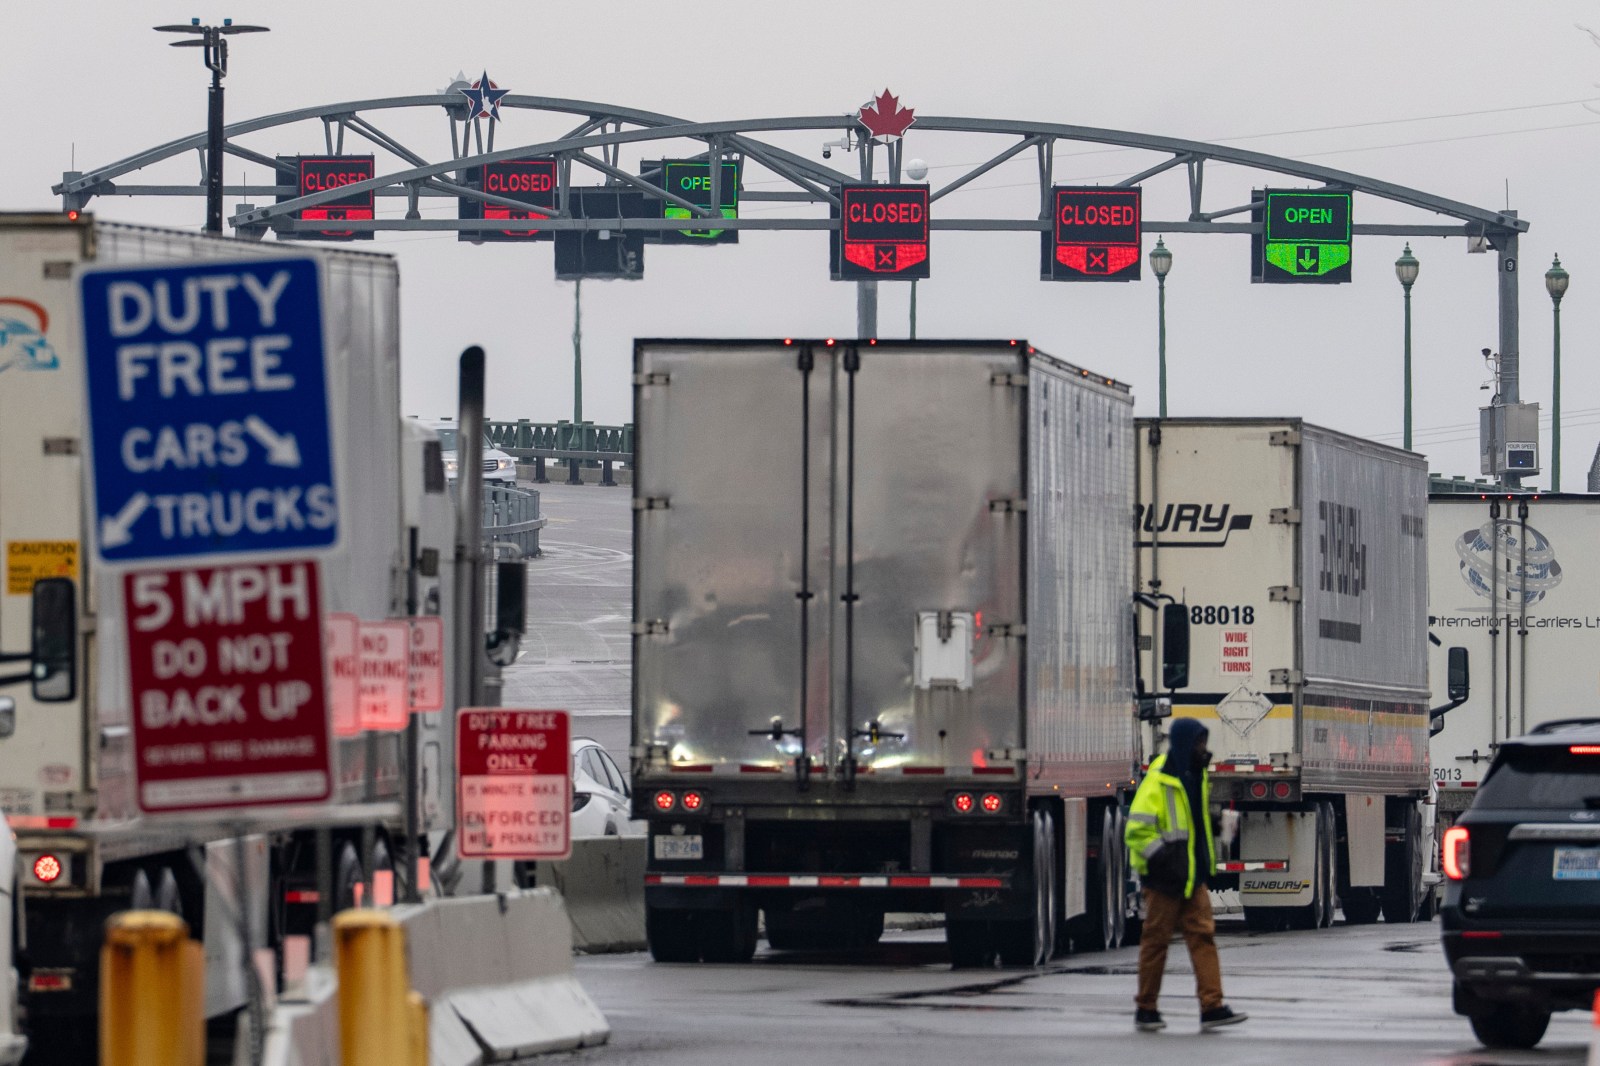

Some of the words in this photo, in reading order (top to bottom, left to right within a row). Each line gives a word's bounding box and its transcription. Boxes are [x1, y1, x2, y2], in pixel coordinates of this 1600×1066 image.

[488, 174, 551, 192] CLOSED
[680, 176, 712, 190] OPE
[850, 203, 922, 223] CLOSED
[1061, 205, 1134, 226] CLOSED
[1285, 207, 1333, 224] OPEN
[1507, 262, 1513, 271] 9
[106, 270, 292, 338] DUTY
[116, 334, 295, 402] FREE
[121, 422, 249, 472] CARS
[152, 482, 335, 540] TRUCKS
[9, 542, 76, 555] CAUTION
[131, 572, 174, 632] 5
[180, 564, 310, 629] MPH
[1191, 605, 1254, 625] 88018
[1429, 615, 1522, 628] nternational
[1525, 616, 1582, 628] Carriers
[1225, 632, 1248, 643] WIDE
[152, 637, 208, 680] DO
[217, 631, 294, 676] NOT
[1223, 646, 1249, 657] RIGHT
[1222, 661, 1251, 673] TURNS
[139, 683, 247, 729] BACK
[257, 679, 312, 722] UP
[468, 714, 511, 731] DUTY
[516, 713, 557, 730] FREE
[478, 733, 547, 750] PARKING
[486, 753, 538, 769] ONLY
[1433, 768, 1462, 781] 5013
[465, 811, 563, 826] ENFORCED
[501, 831, 560, 845] PENALTY
[1243, 880, 1303, 890] SUNBURY
